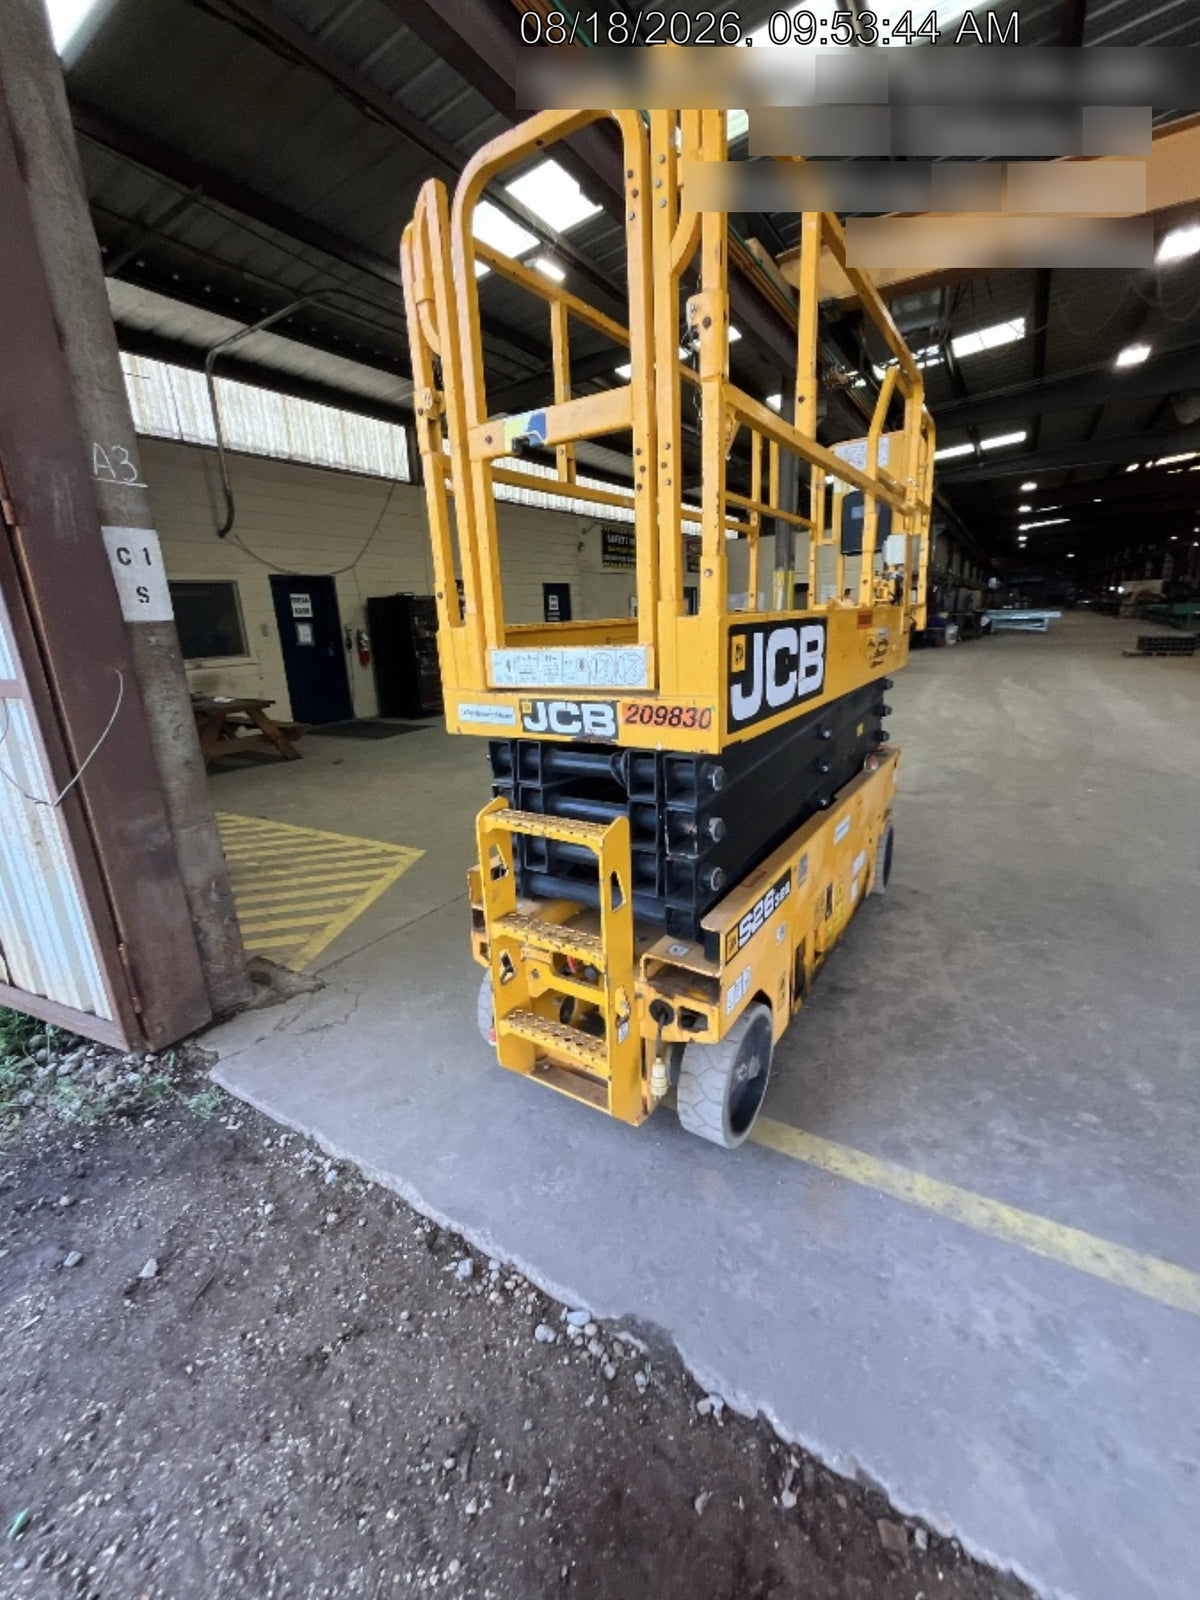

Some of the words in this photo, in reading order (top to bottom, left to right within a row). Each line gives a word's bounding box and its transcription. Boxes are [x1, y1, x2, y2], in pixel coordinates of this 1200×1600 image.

[93, 442, 138, 484] A3
[116, 546, 132, 566] C
[136, 586, 150, 604] S
[730, 625, 825, 720] JCB
[523, 701, 616, 737] JCB
[625, 704, 712, 729] 209830
